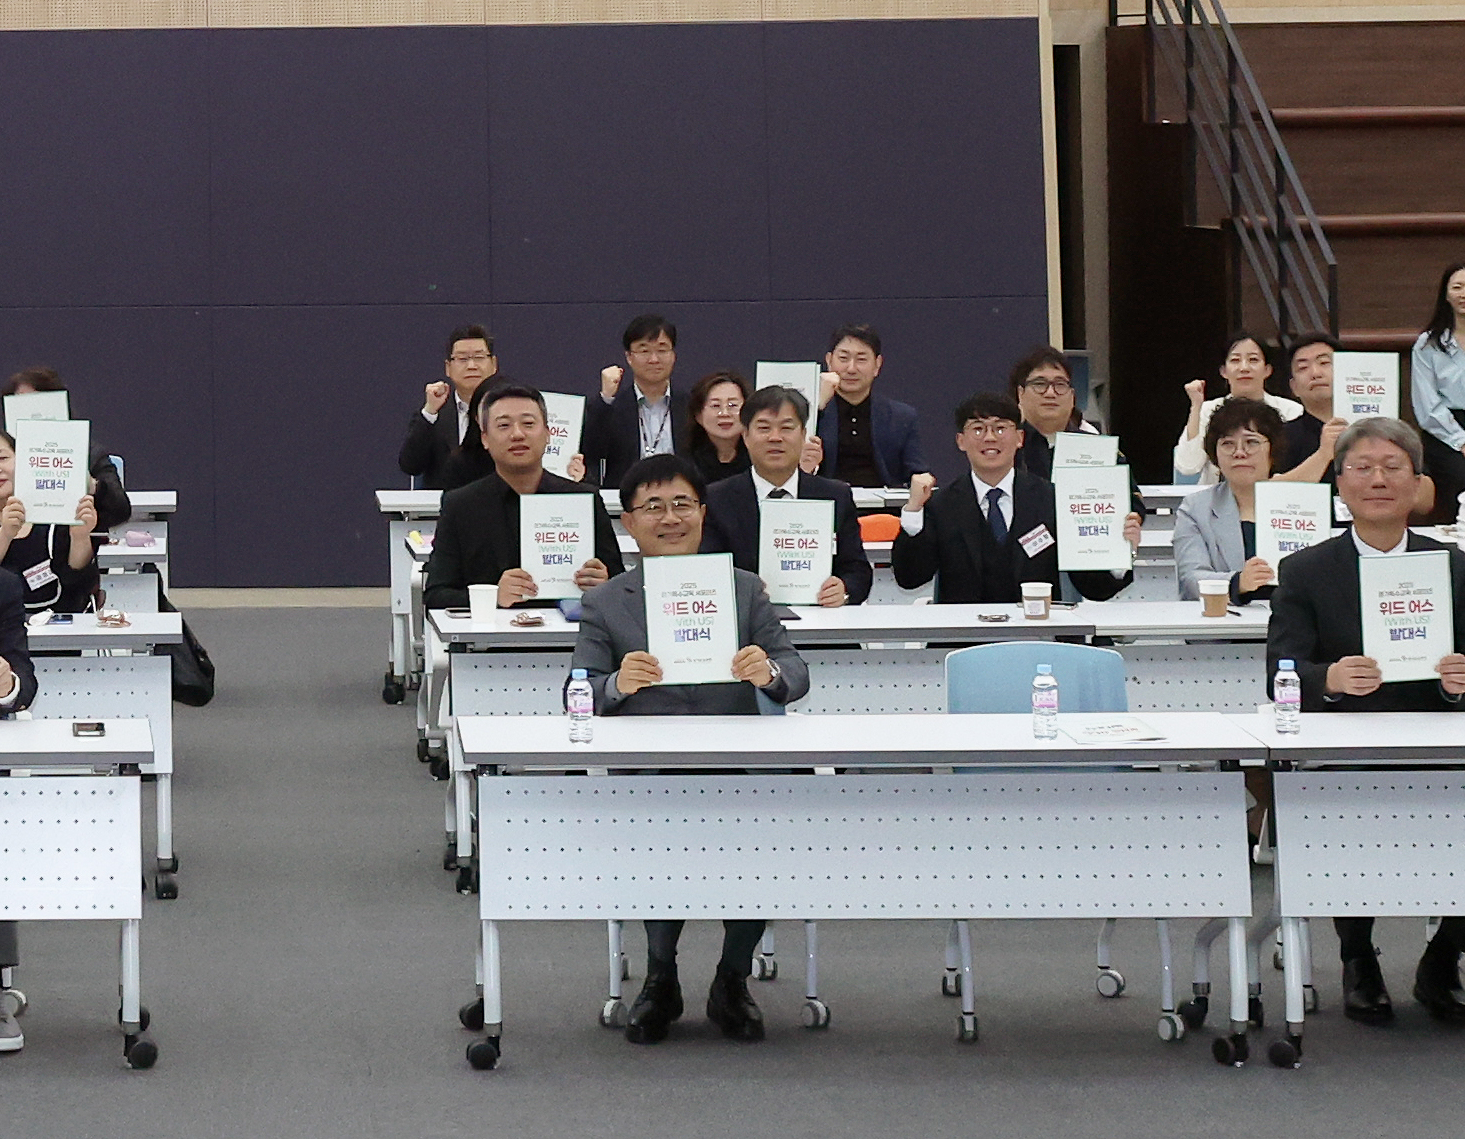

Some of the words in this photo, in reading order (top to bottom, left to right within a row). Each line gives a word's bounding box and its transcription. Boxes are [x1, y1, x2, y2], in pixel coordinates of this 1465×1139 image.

[28, 456, 50, 468] 위드
[52, 457, 74, 469] 어스
[35, 478, 66, 491] 발대식
[1069, 503, 1092, 515] 위드
[1093, 502, 1116, 514] 어스
[1077, 524, 1109, 537] 발대식
[534, 531, 557, 544] 위드
[558, 531, 580, 543] 어스
[773, 537, 795, 549] 위드
[797, 537, 819, 550] 어스
[542, 553, 573, 565] 발대식
[780, 559, 811, 571] 발대식
[1379, 600, 1406, 616] 위드
[1408, 598, 1434, 614] 어스
[1389, 625, 1427, 642] 발대식
